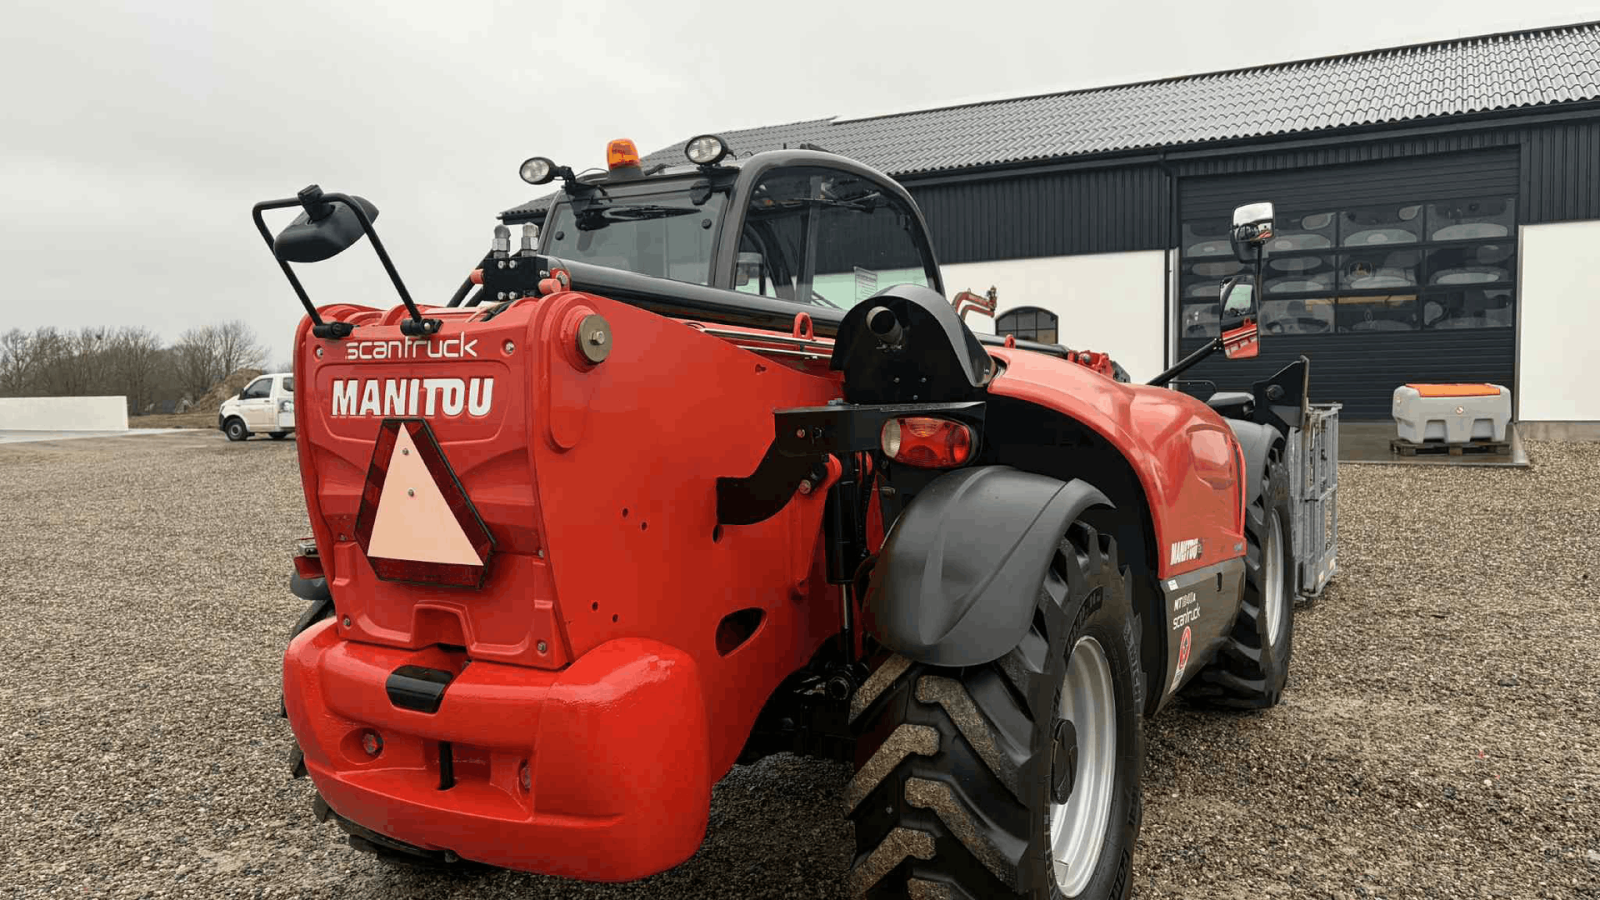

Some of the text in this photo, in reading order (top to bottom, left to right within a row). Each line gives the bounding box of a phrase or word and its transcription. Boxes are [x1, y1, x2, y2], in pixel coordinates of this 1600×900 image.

[346, 331, 478, 359] scantruck
[332, 378, 494, 416] MANITOU
[1170, 538, 1201, 566] MANITOU
[1172, 602, 1201, 631] scantruck
